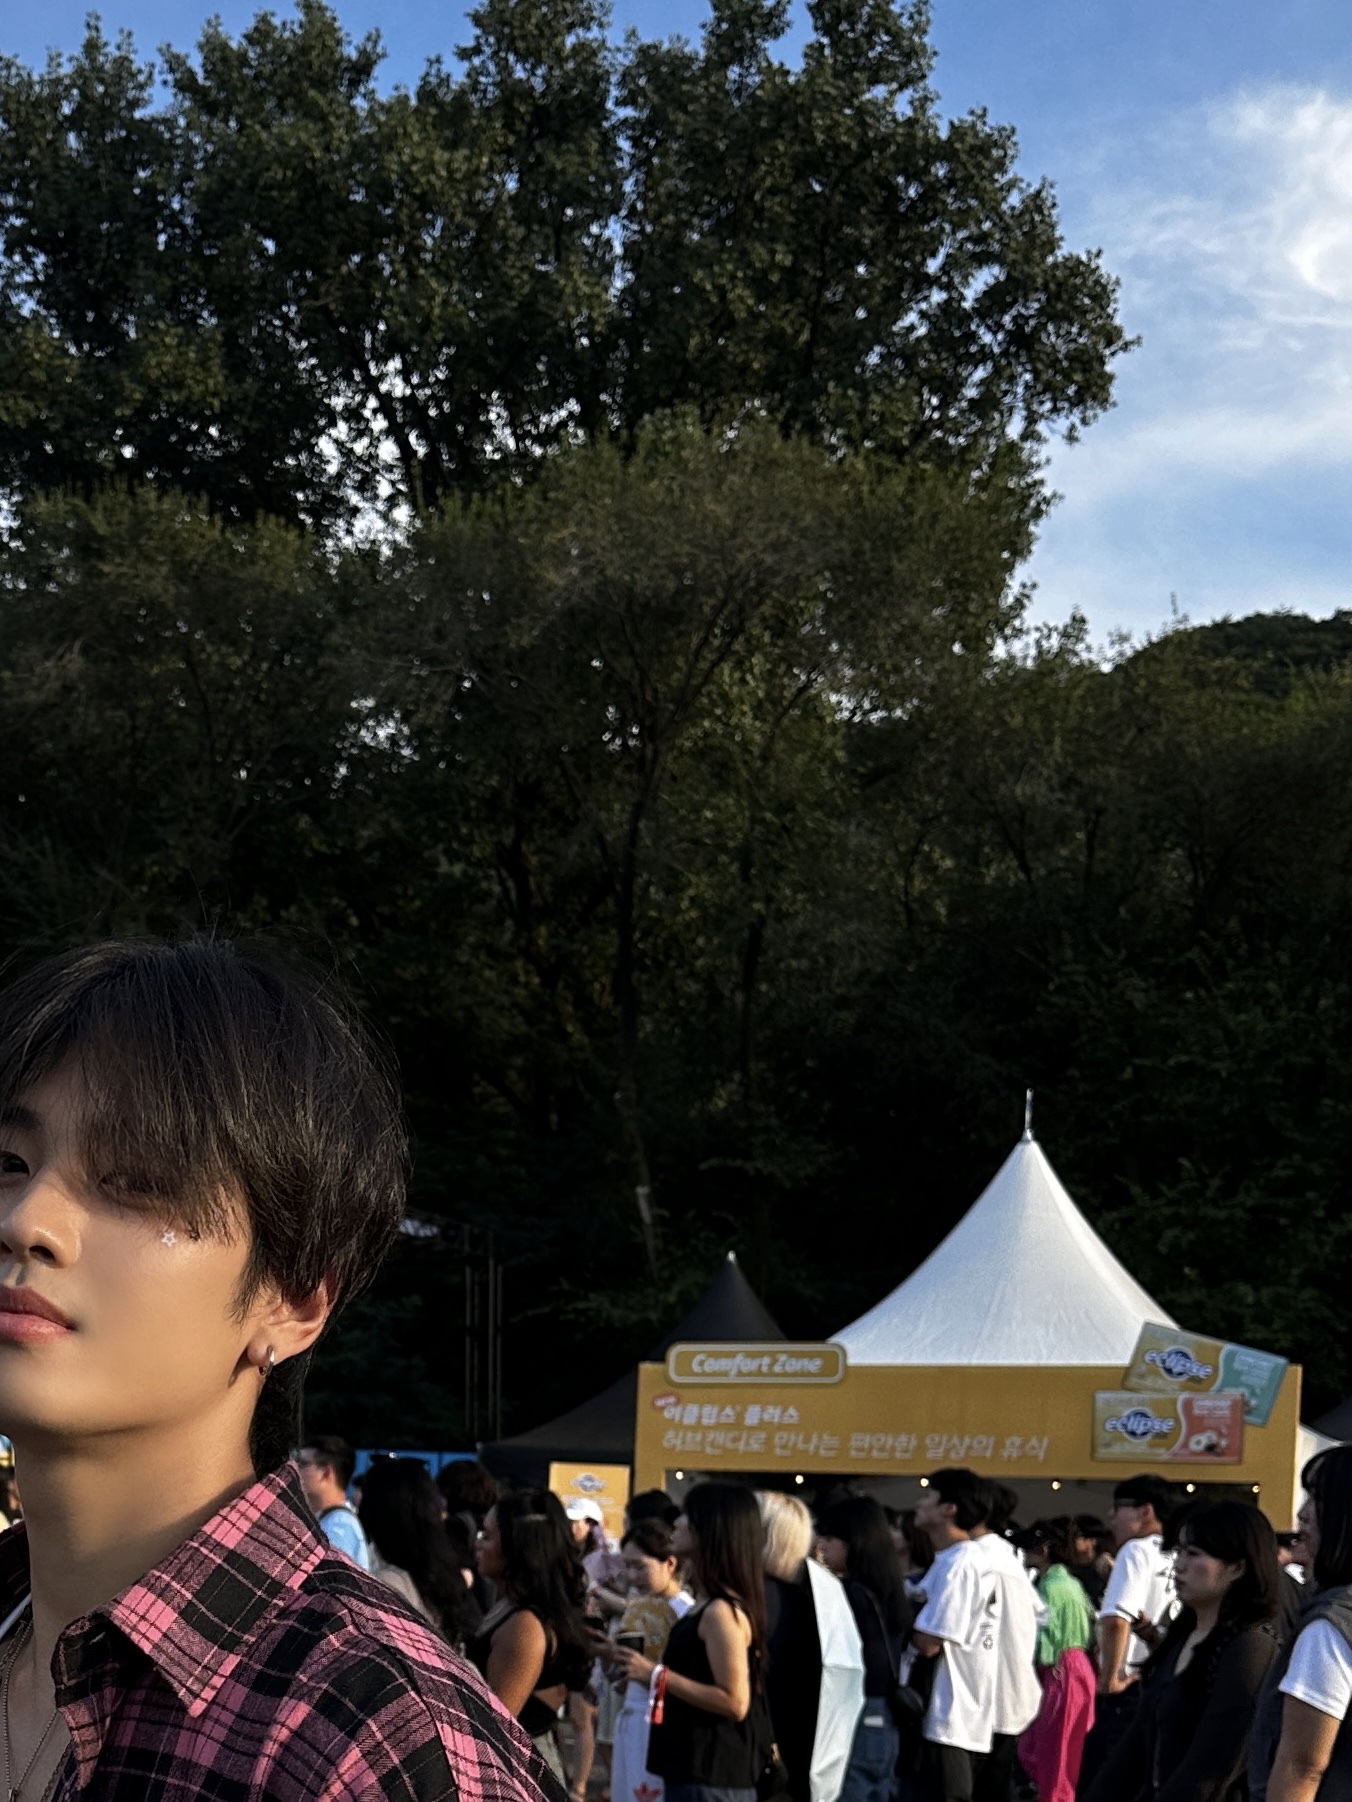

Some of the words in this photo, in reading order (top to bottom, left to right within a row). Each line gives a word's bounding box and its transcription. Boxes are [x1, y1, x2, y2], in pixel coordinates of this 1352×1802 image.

[692, 1353, 771, 1377] Comfort
[773, 1353, 823, 1374] Zone
[1145, 1351, 1212, 1378] eclipse
[663, 1404, 737, 1426] 이클립스
[744, 1404, 801, 1427] 플러스
[1105, 1416, 1175, 1436] eclipse
[662, 1429, 768, 1456] 허브캔디로
[774, 1430, 841, 1458] 만나는
[849, 1431, 918, 1460] 편안한
[925, 1433, 997, 1462] 일상의
[1002, 1435, 1049, 1462] 휴식
